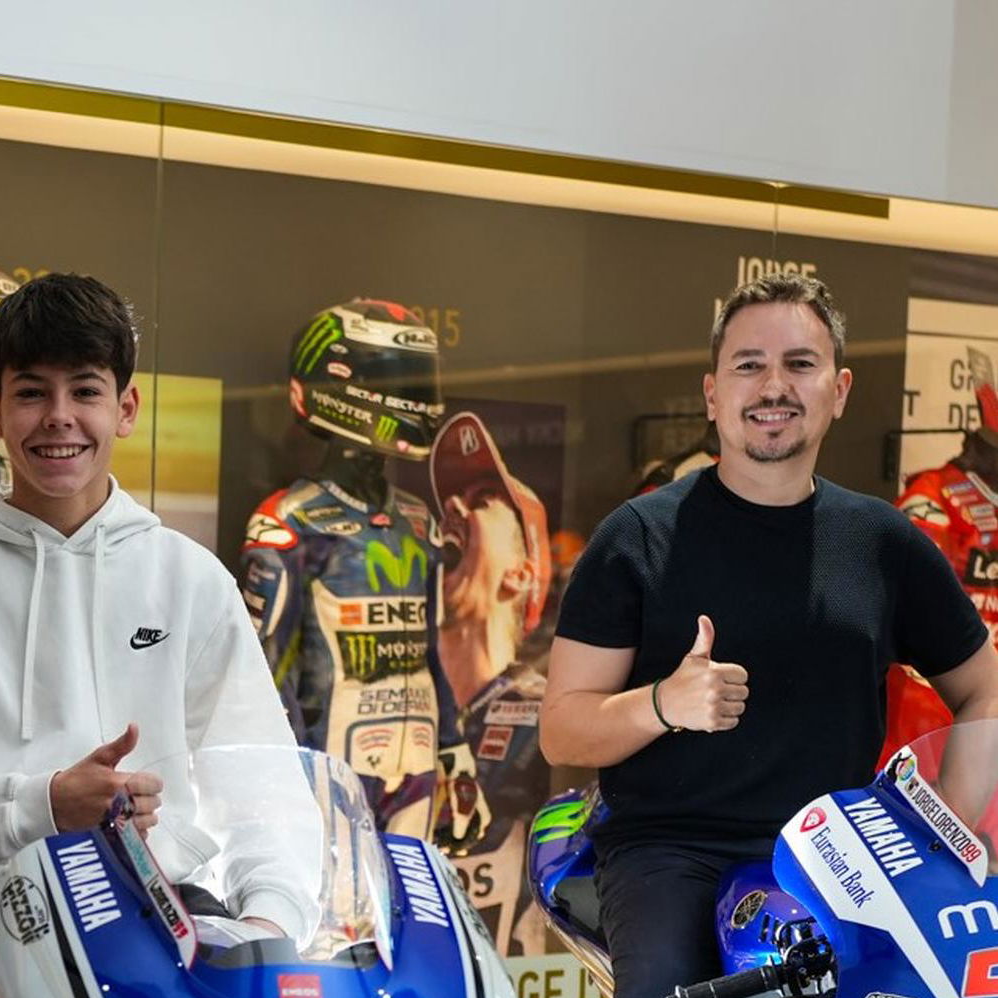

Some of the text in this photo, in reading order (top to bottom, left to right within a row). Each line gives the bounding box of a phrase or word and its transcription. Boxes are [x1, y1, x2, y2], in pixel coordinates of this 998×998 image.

[134, 627, 163, 642] NIKE
[810, 825, 875, 909] Eurasian Bank
[843, 797, 924, 878] YAMAHA
[56, 839, 122, 933] YAMAHA
[391, 843, 450, 928] YAMAHA
